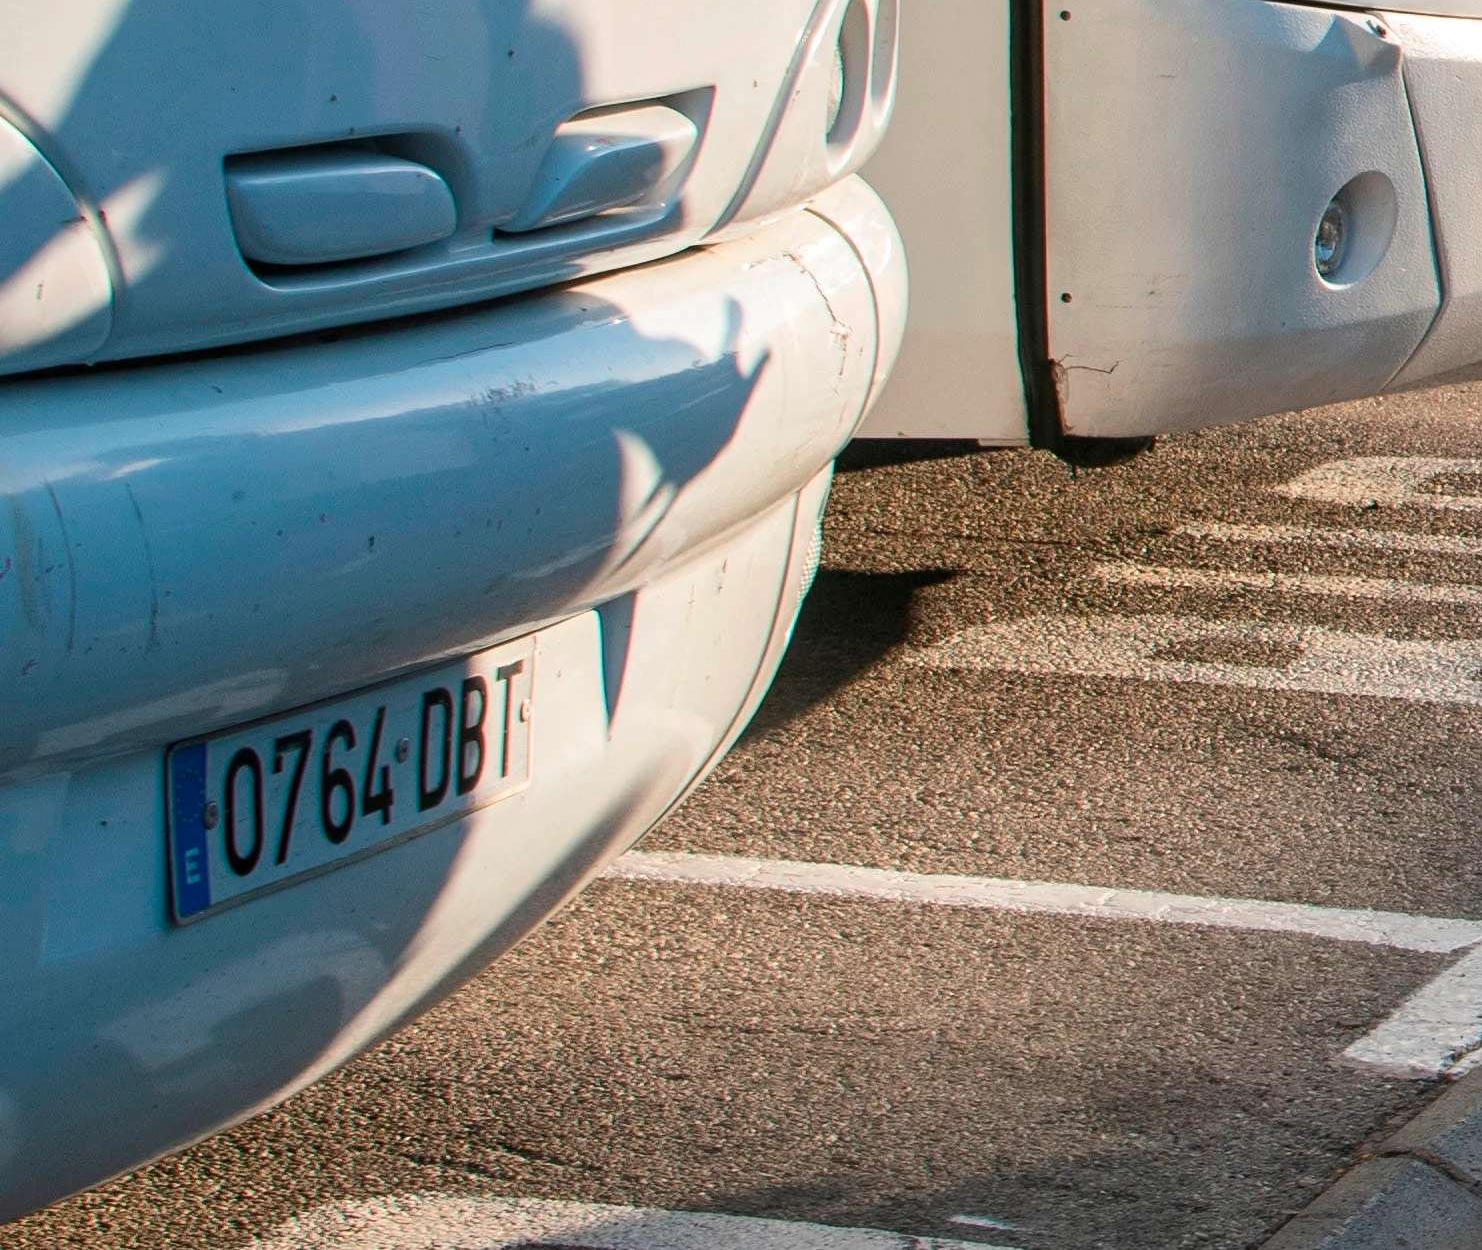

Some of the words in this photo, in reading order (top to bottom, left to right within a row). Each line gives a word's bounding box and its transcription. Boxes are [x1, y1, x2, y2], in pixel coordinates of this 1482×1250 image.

[184, 848, 201, 885] E
[224, 705, 395, 877] 0764
[417, 659, 525, 813] DBT
